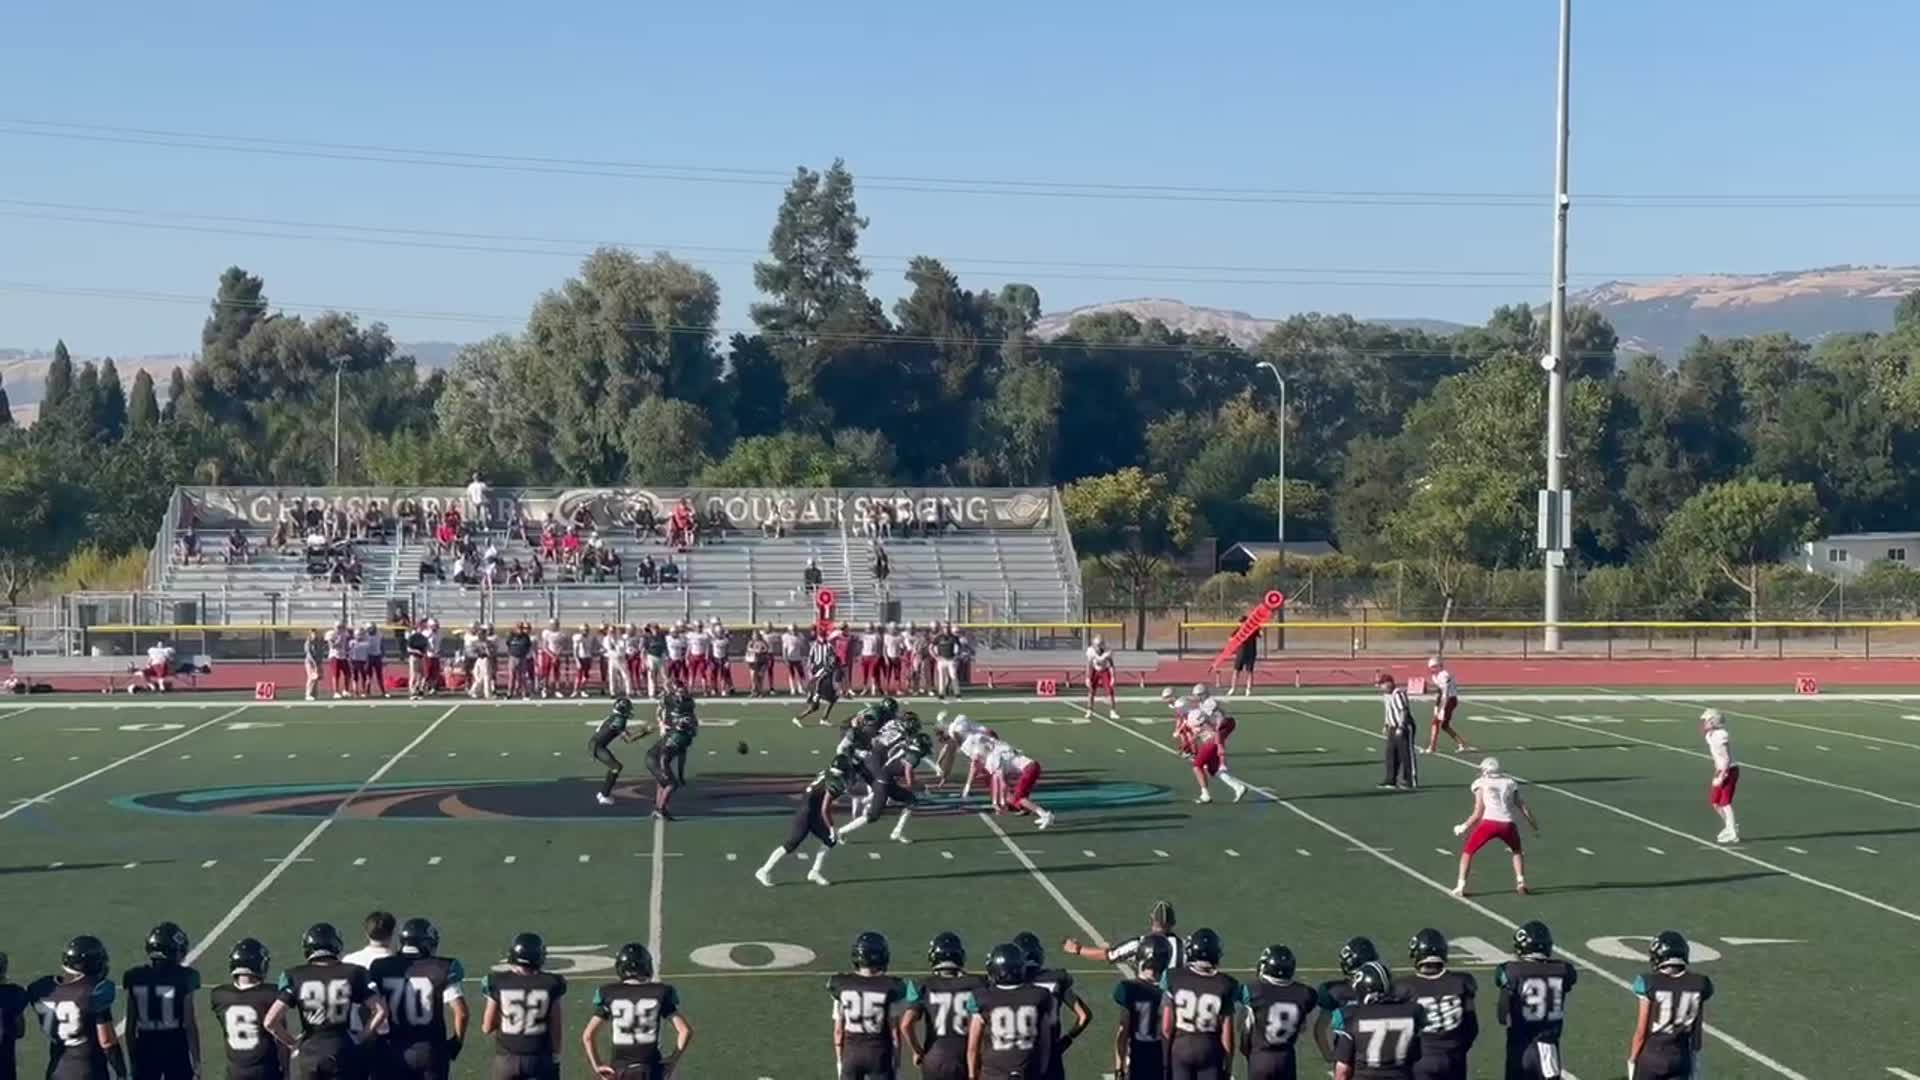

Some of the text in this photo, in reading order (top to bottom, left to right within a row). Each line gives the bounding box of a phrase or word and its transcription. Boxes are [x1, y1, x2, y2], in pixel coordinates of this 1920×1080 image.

[251, 496, 515, 523] CHRISTOPHR
[707, 497, 845, 522] COUGAR
[257, 683, 273, 698] 40
[1039, 680, 1054, 694] 40
[1801, 679, 1816, 692] 20
[132, 986, 179, 1030] 11
[382, 976, 433, 1025] 70
[500, 989, 549, 1034] 52
[840, 989, 886, 1033] 25
[1175, 989, 1221, 1032] 28
[1522, 977, 1564, 1021] 31
[1651, 990, 1701, 1034] 14
[225, 1005, 259, 1049] 6
[610, 999, 658, 1044] 23
[1265, 1002, 1300, 1045] 8
[1358, 1017, 1414, 1067] 77
